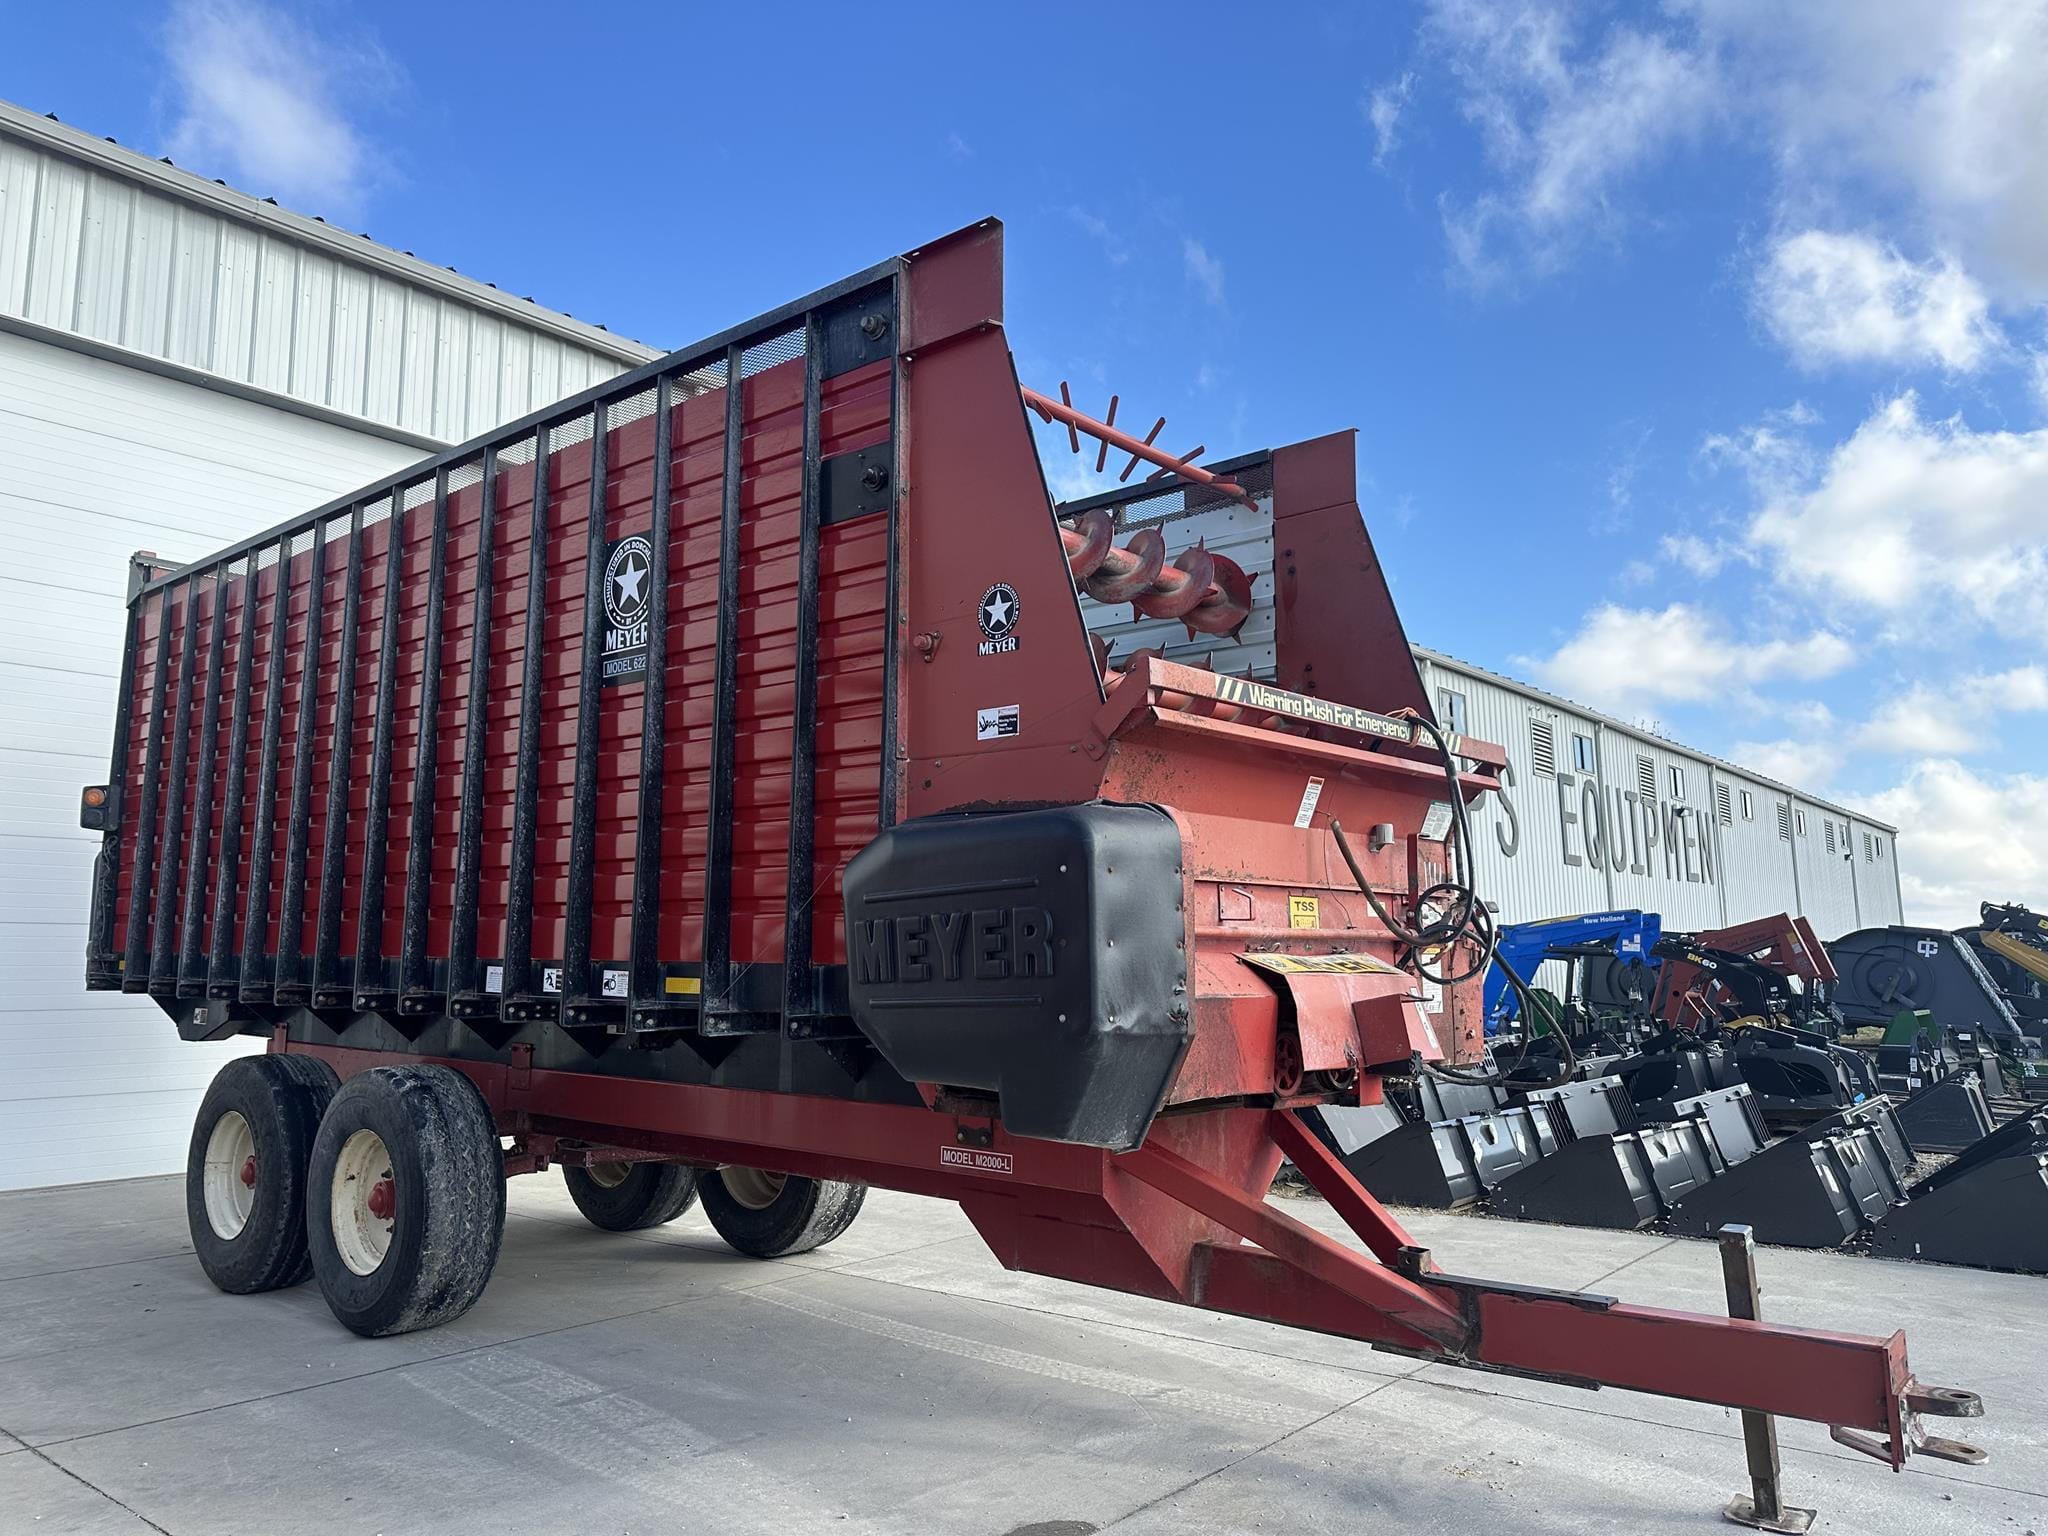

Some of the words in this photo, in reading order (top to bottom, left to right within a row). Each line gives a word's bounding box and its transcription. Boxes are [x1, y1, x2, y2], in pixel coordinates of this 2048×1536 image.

[605, 622, 648, 652] MEYER
[978, 637, 1016, 657] MEYER
[606, 659, 633, 675] MODEL
[1248, 683, 1302, 716] Warning
[1303, 697, 1334, 722] Push
[1334, 706, 1354, 727] For
[1354, 709, 1411, 741] Emergency
[1418, 729, 1437, 747] top
[1556, 772, 1717, 886] EQUIPMEN
[1294, 901, 1315, 912] TSS
[1599, 914, 1626, 924] Holland
[853, 905, 1055, 985] MEYER
[943, 1149, 974, 1165] MODEL
[975, 1154, 1011, 1171] M2000-L
